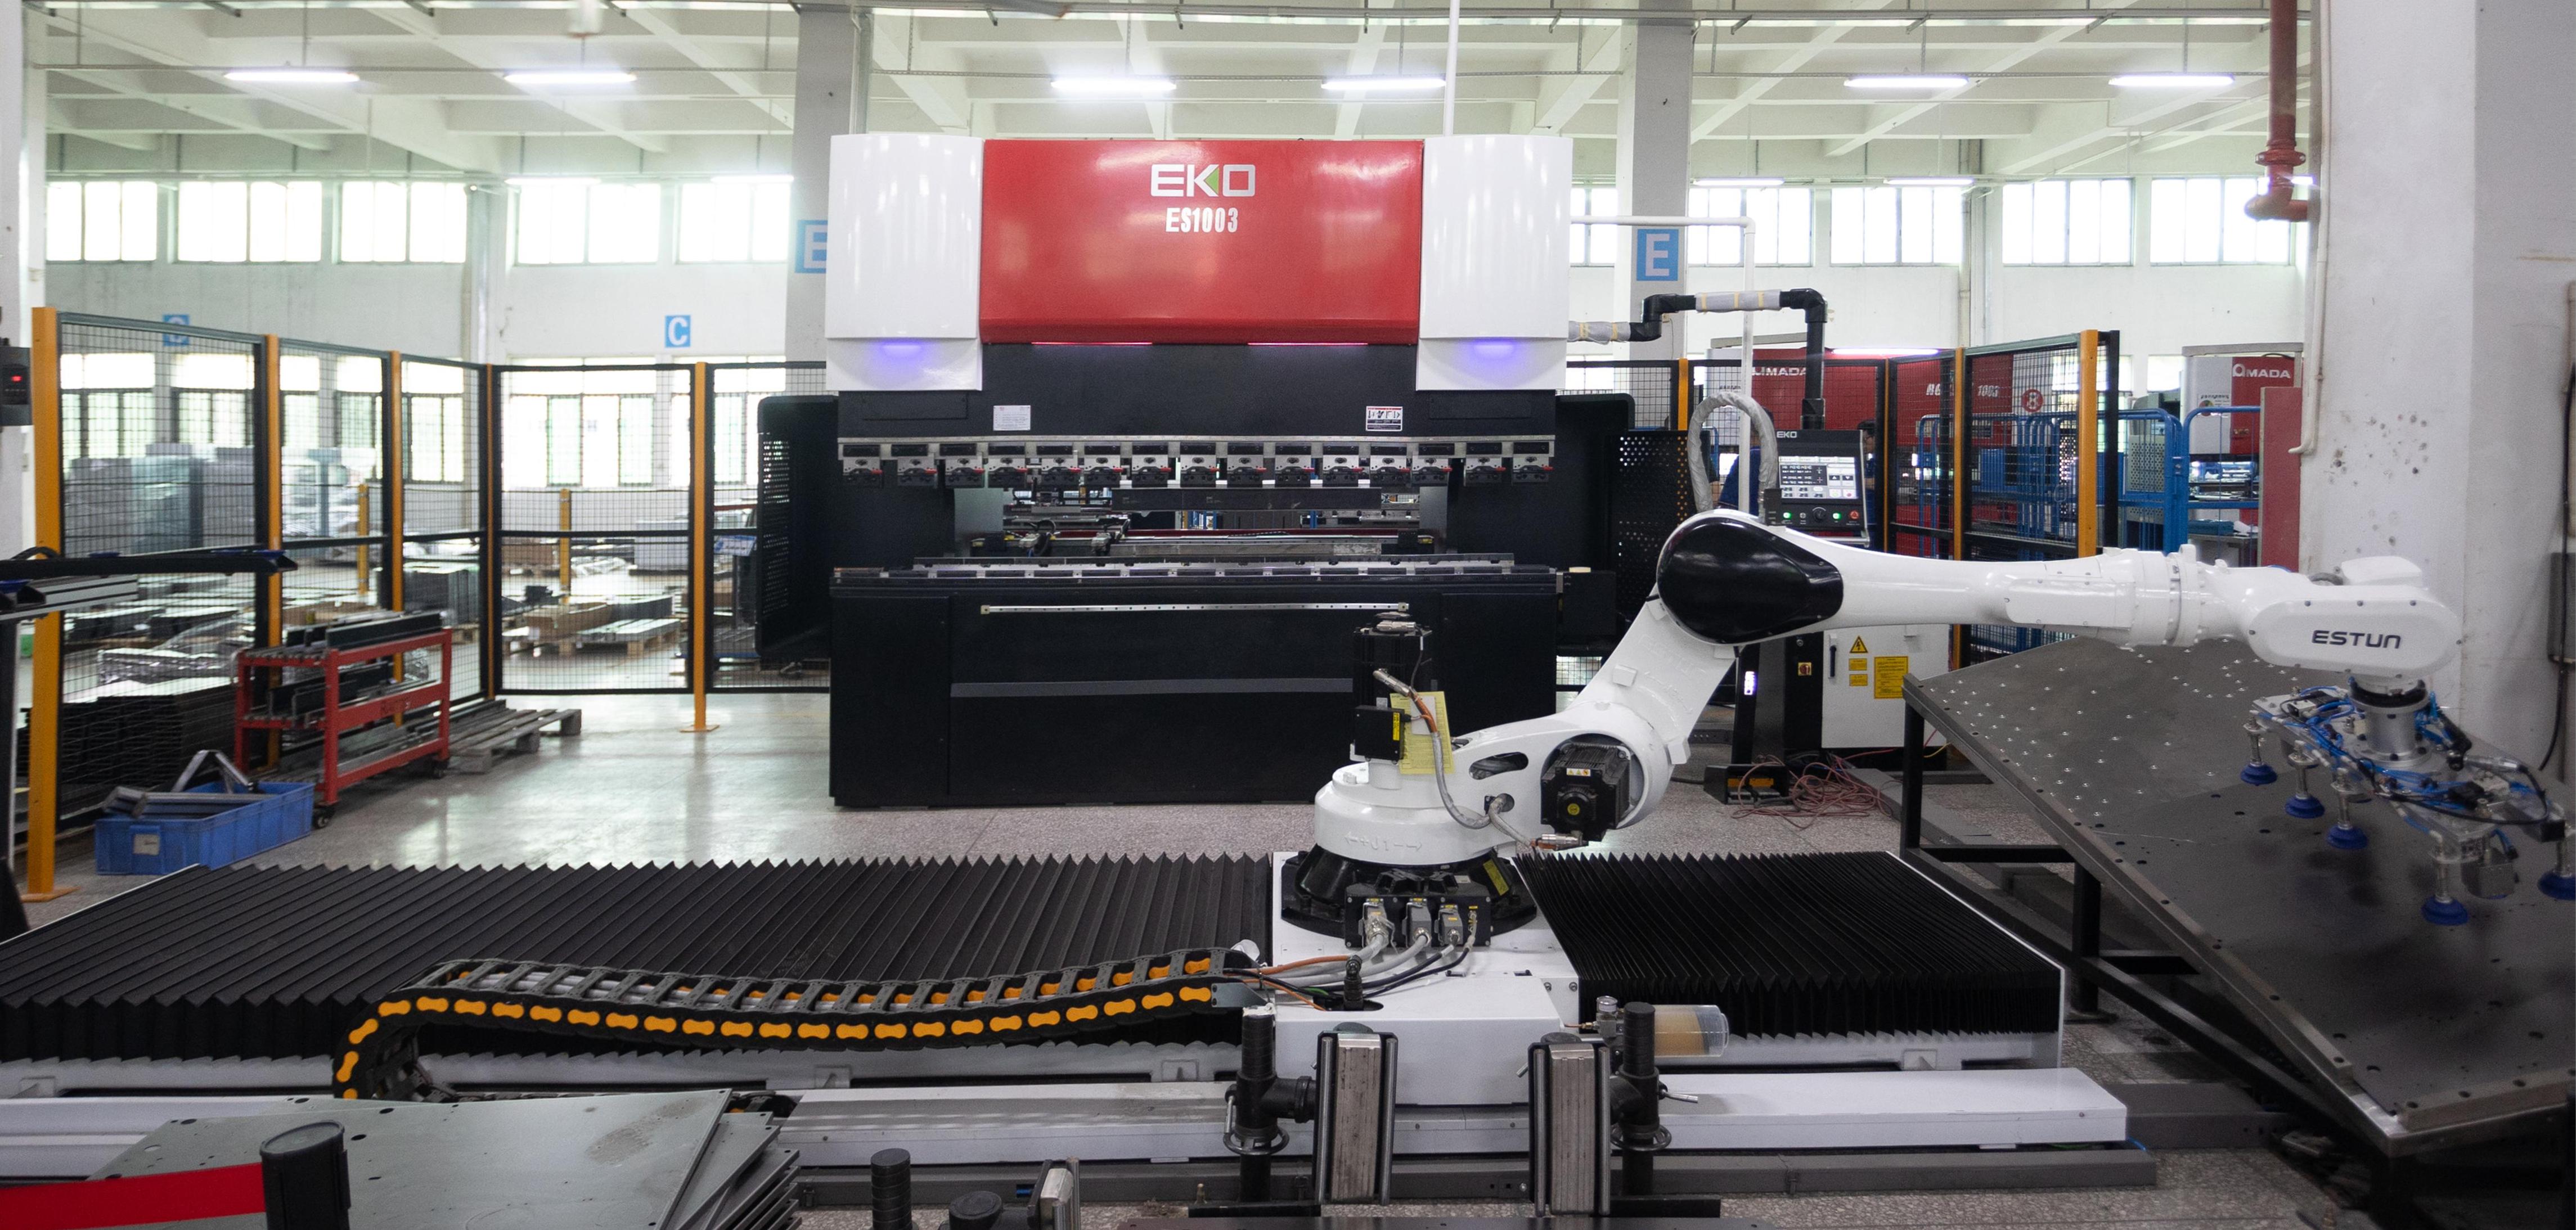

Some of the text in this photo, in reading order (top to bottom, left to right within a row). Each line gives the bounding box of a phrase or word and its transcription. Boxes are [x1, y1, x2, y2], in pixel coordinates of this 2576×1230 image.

[1151, 164, 1256, 197] EKO
[1166, 208, 1238, 233] ES1003
[1646, 233, 1670, 276] E
[668, 317, 687, 345] C
[2232, 364, 2291, 379] AMADA
[2312, 630, 2401, 649] ESTUN
